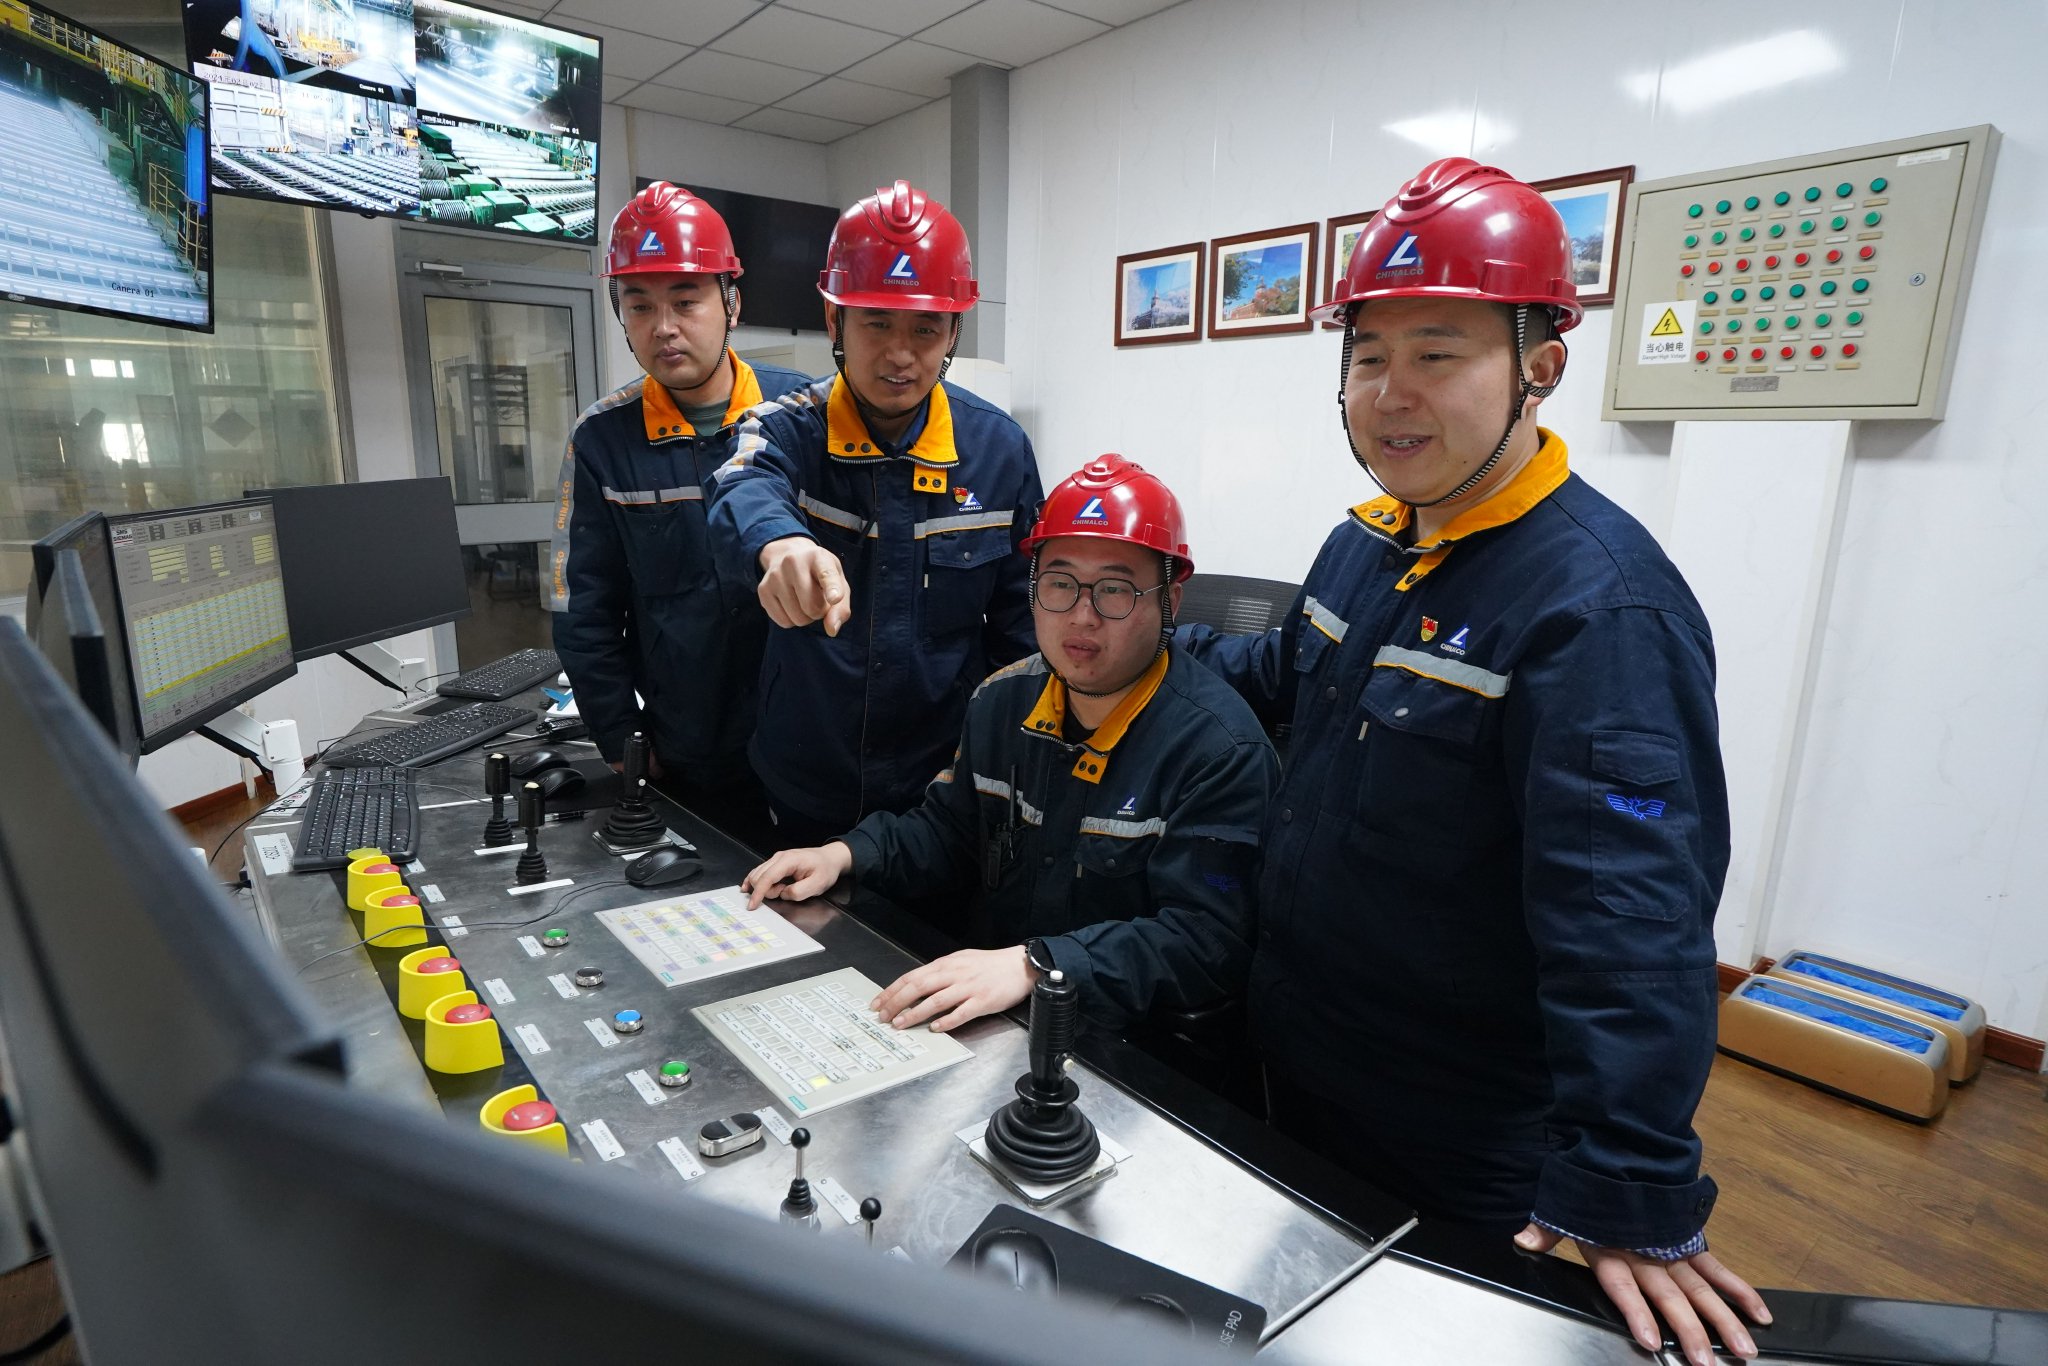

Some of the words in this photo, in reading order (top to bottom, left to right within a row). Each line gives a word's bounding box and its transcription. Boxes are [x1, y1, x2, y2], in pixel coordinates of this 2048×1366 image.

[1375, 268, 1424, 280] CHINALCO
[111, 282, 141, 295] Camera
[144, 288, 154, 298] 01
[883, 278, 920, 287] CHINALCO
[1646, 341, 1685, 353] 当心触电
[557, 480, 572, 530] CHINALCO
[556, 550, 566, 600] CHINALCO
[1225, 1310, 1242, 1331] PAD
